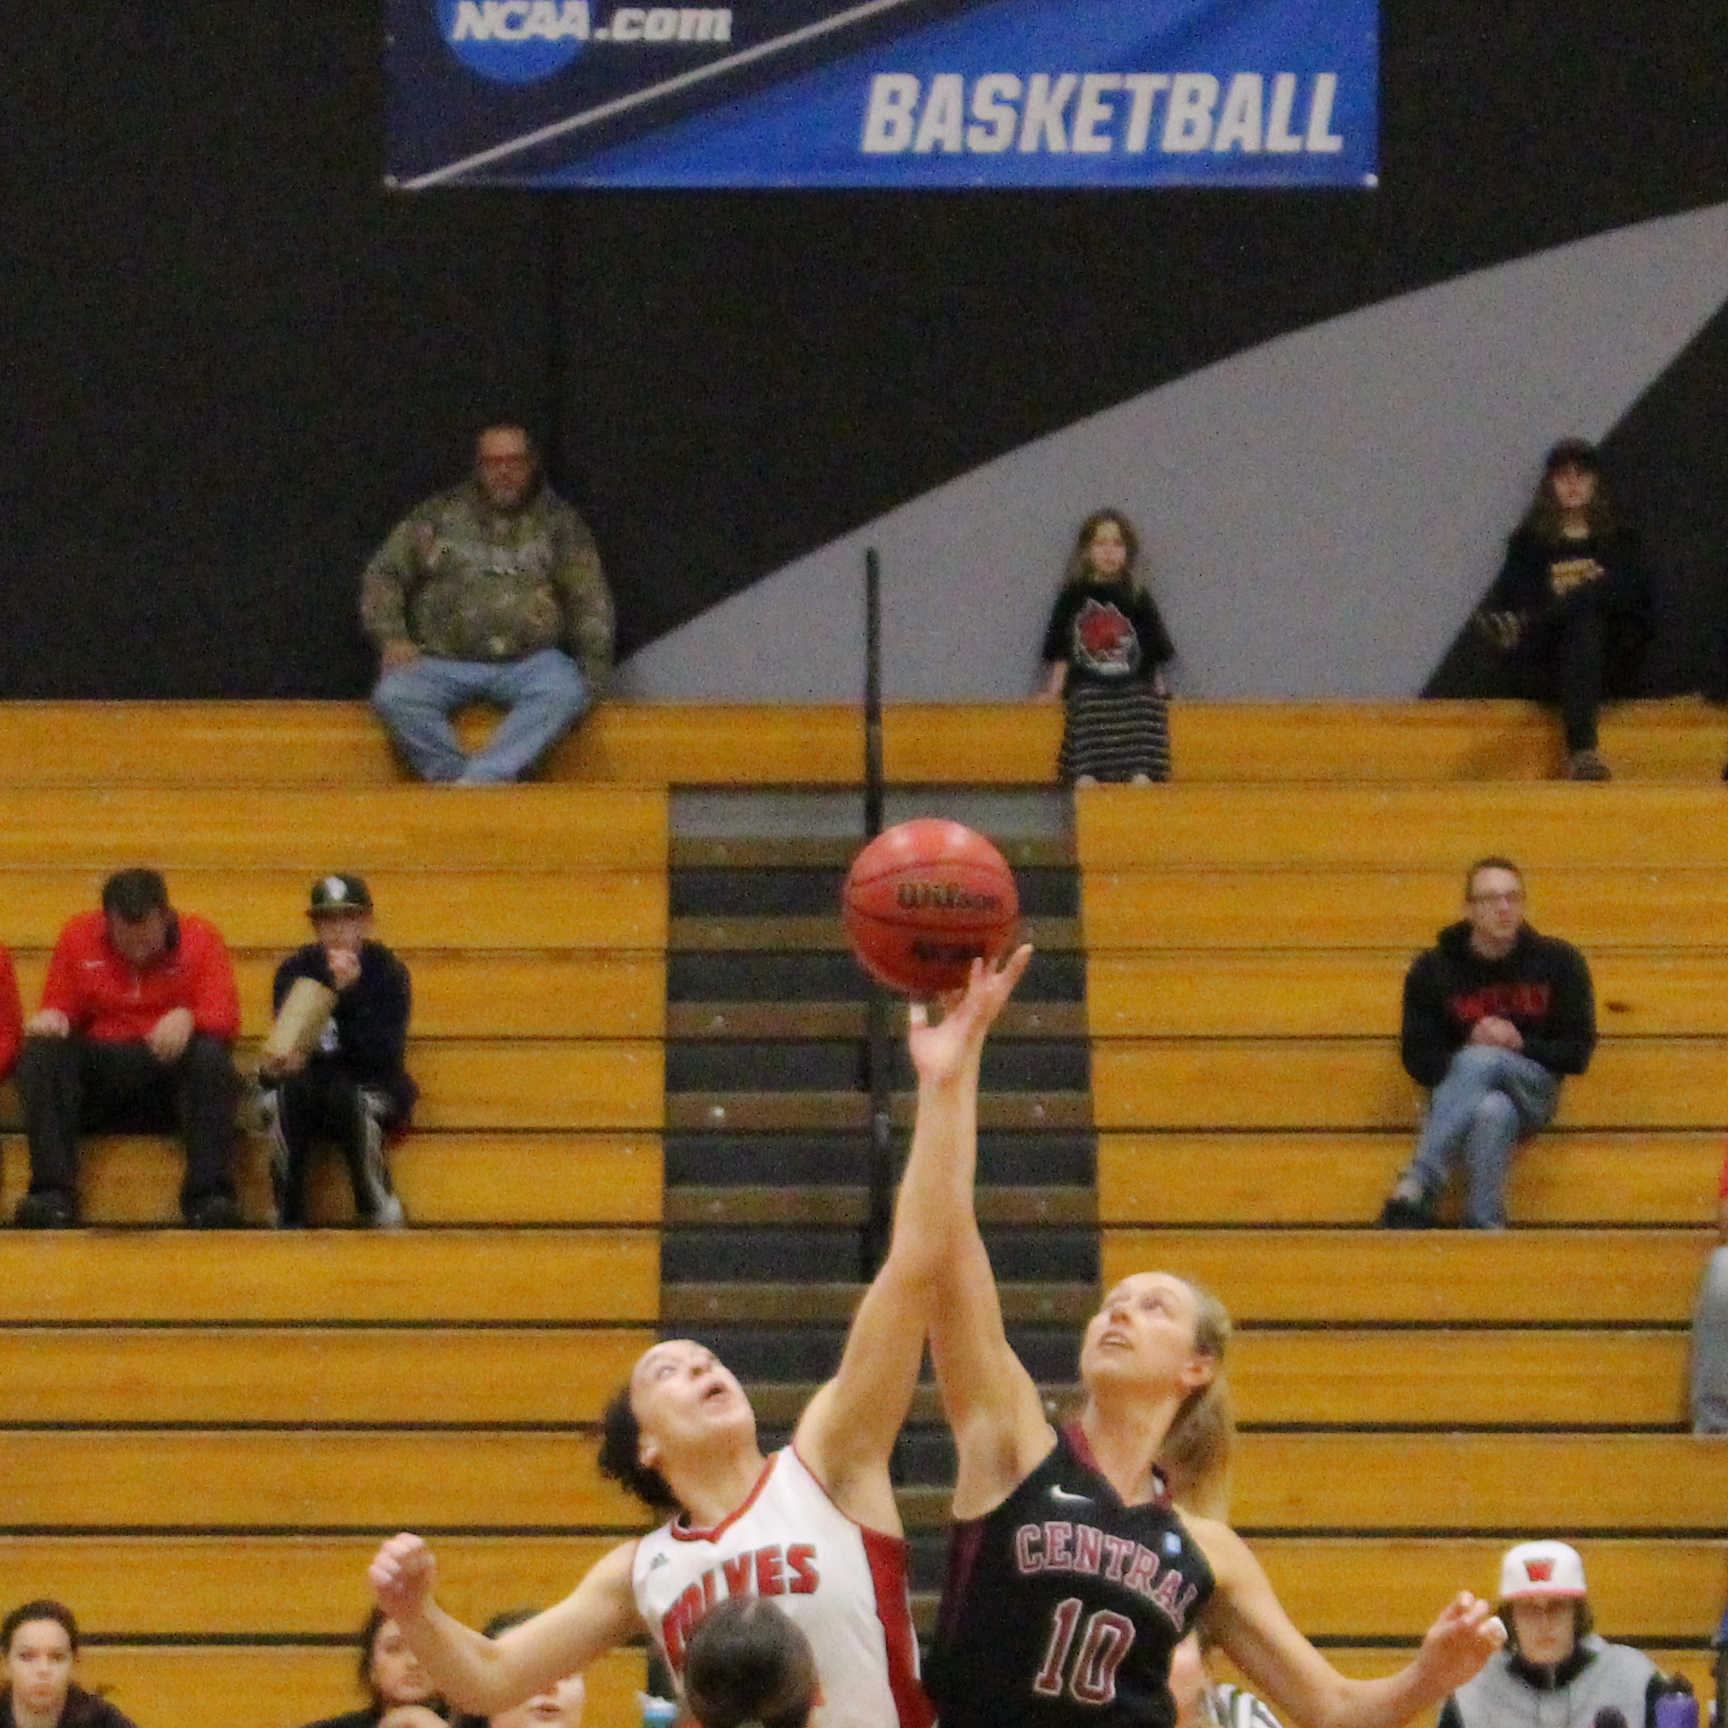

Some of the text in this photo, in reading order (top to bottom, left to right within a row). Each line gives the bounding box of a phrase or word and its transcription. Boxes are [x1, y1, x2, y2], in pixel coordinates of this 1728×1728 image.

[451, 0, 733, 42] NCAA.com
[862, 72, 1344, 153] BASKETBALL
[1016, 1520, 1198, 1633] CENTRAL
[1033, 1597, 1136, 1706] 10
